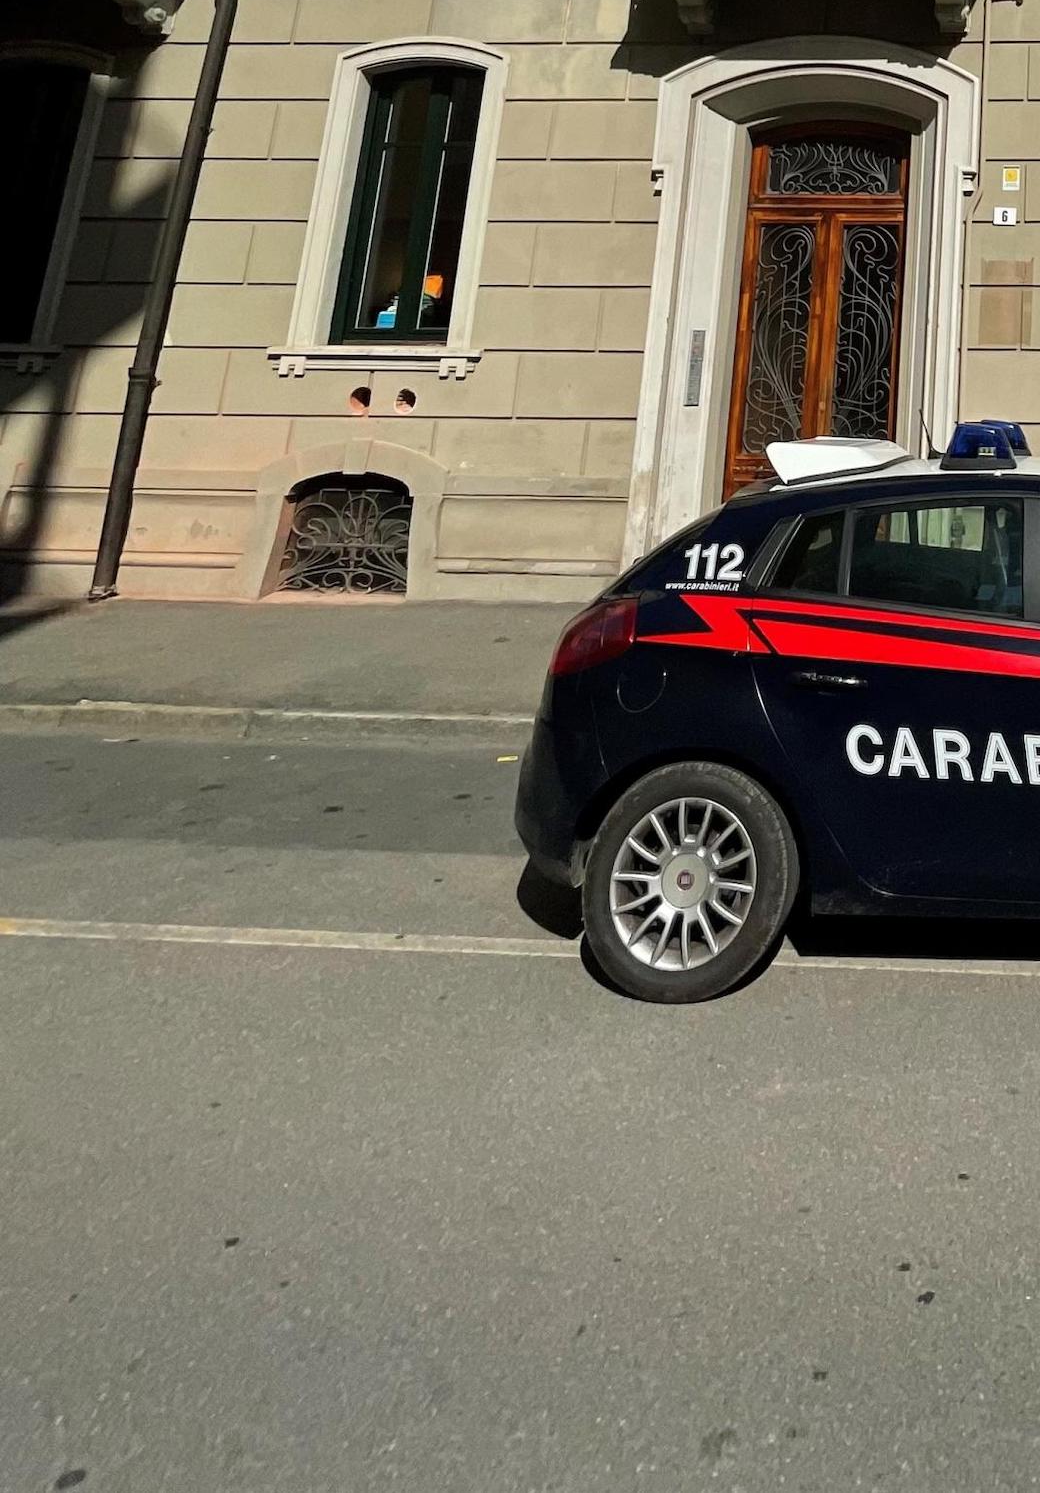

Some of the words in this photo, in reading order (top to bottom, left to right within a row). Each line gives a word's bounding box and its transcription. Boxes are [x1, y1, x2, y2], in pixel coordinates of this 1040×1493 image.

[1001, 210, 1008, 222] 6
[684, 543, 745, 581] 112
[665, 582, 740, 592] www.carabinieri.it
